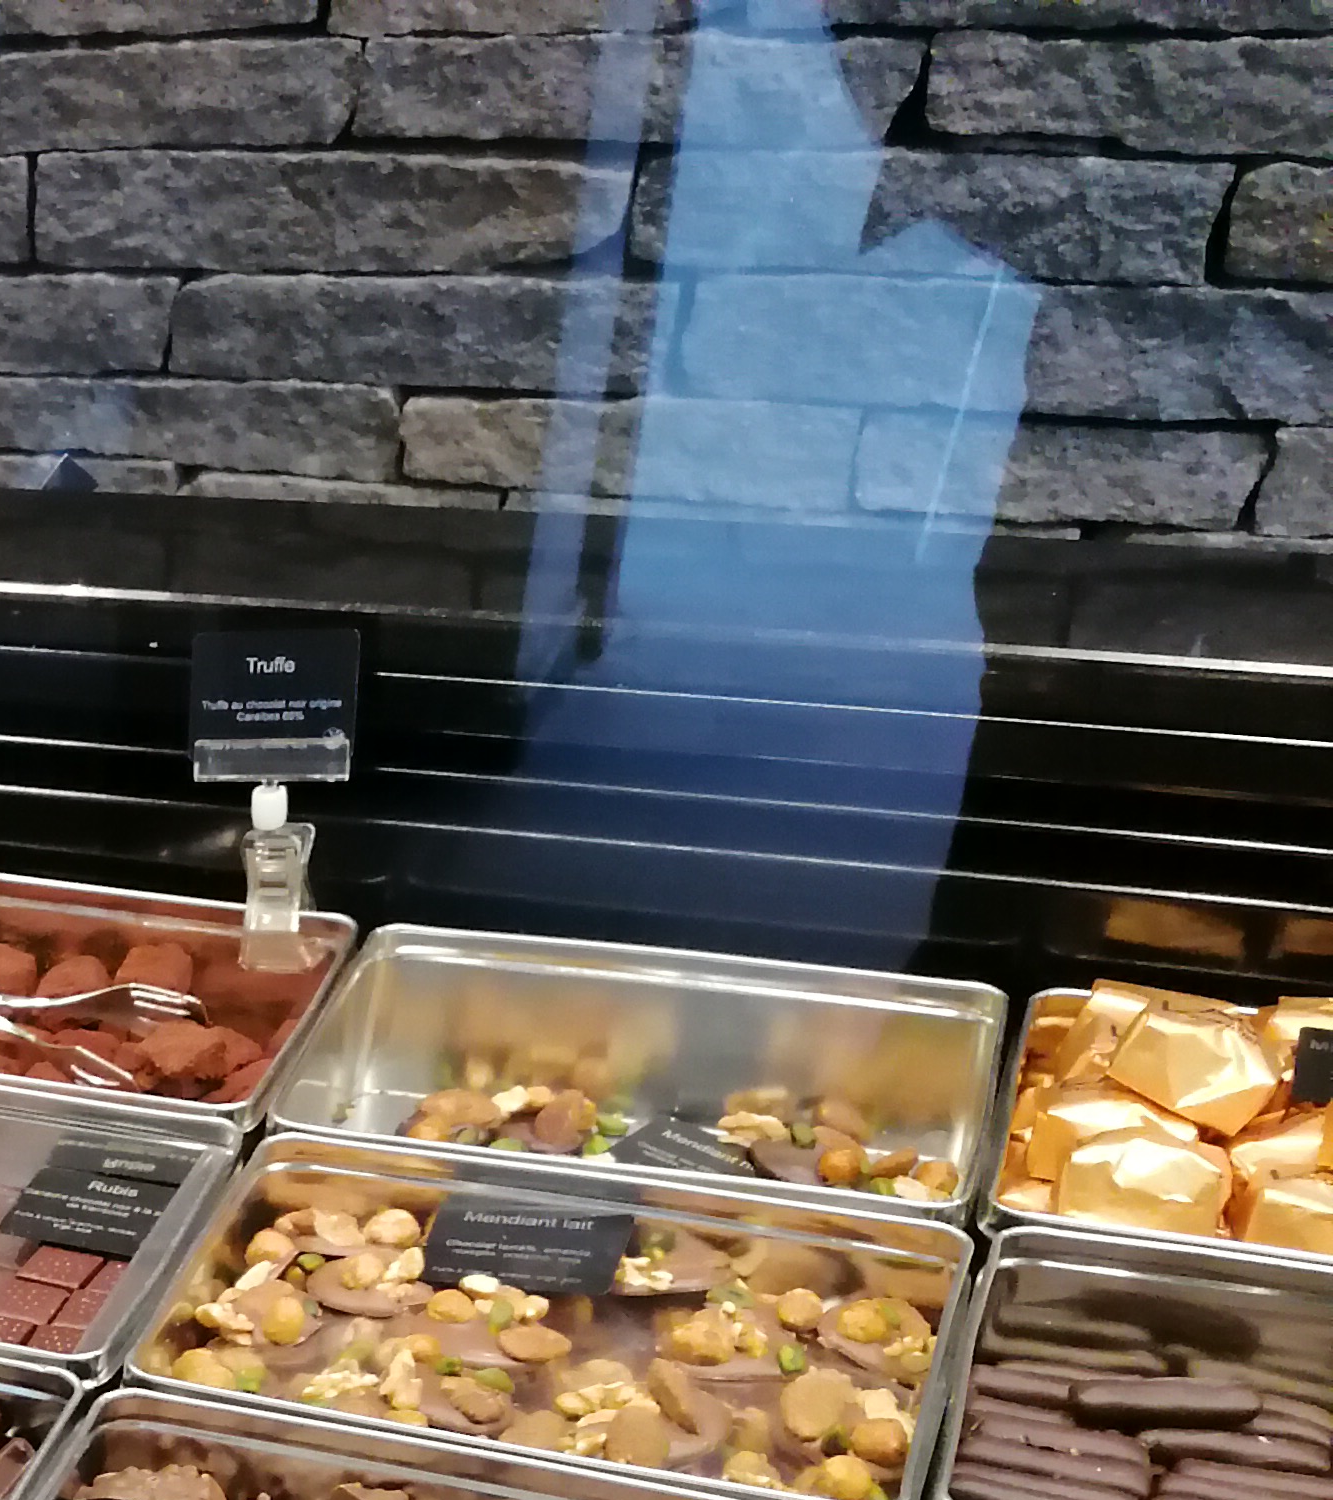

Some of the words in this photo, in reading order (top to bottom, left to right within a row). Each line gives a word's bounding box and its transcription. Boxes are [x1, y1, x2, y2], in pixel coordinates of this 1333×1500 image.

[245, 656, 296, 674] Truffe
[87, 1180, 139, 1198] Rubis
[463, 1210, 557, 1229] Mendiant
[563, 1218, 595, 1231] lait
